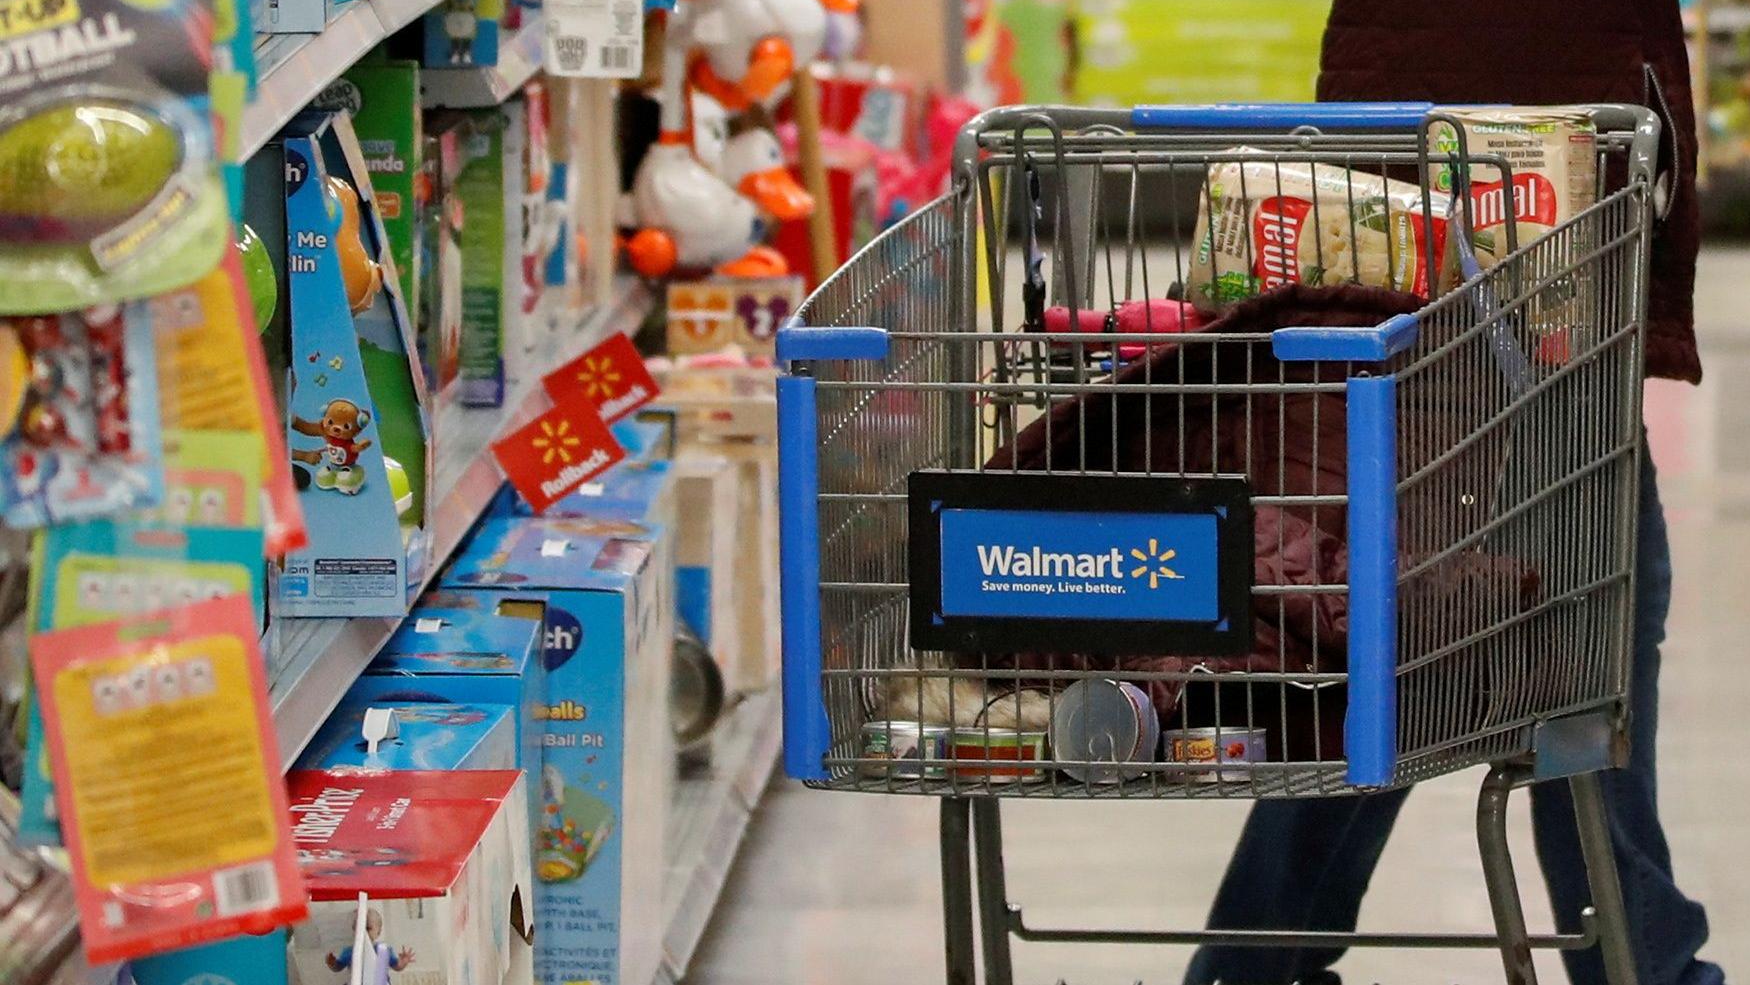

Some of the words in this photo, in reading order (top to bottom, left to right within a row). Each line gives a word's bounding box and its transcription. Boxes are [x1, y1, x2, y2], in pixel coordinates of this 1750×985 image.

[297, 232, 327, 248] Me
[540, 448, 611, 498] Rollback
[977, 545, 1123, 578] Walmart
[982, 580, 1010, 592] Save
[1012, 582, 1055, 594] money.
[1058, 582, 1083, 593] Live
[1085, 583, 1126, 594] better.
[545, 734, 575, 746] Ball
[582, 734, 604, 747] Pit
